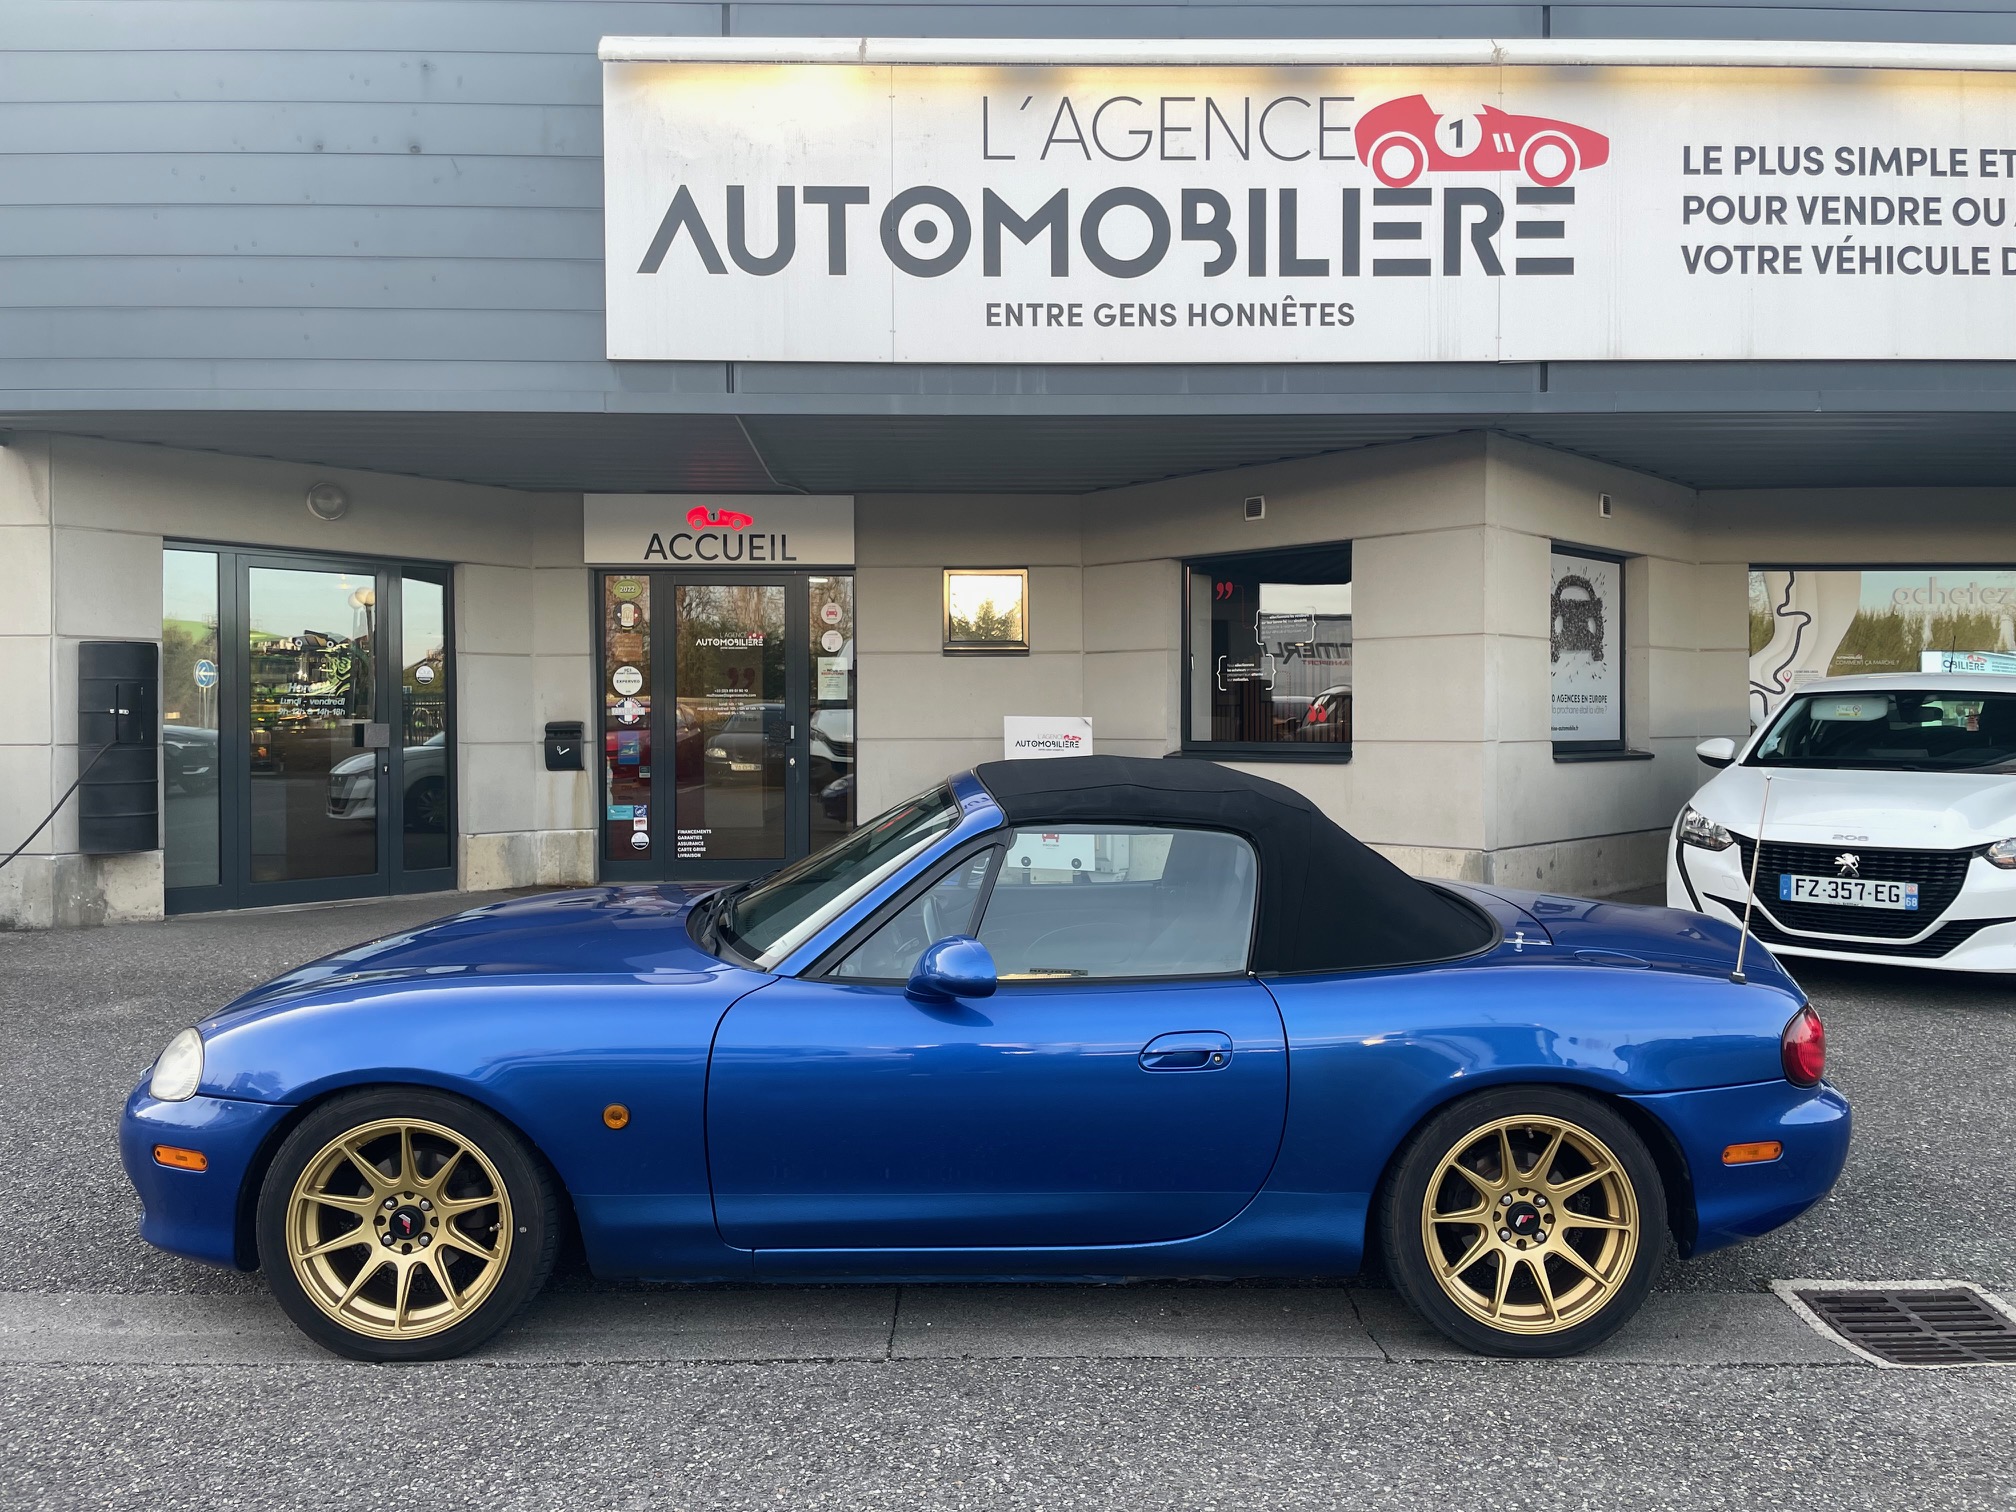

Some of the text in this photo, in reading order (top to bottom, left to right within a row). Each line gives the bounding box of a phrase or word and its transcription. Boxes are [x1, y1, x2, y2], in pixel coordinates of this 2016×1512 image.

[983, 95, 1356, 162] L'AGENCE
[1449, 118, 1463, 148] 1
[1683, 145, 2016, 178] LE PLUS SIMPLE ET
[1683, 195, 2006, 227] POUR VENDRE OU
[1681, 244, 1802, 275] VOTRE
[1811, 234, 1991, 276] VÉHICULE
[986, 294, 1355, 327] ENTRE GENS HONNÊTES
[710, 512, 717, 521] 1
[643, 533, 797, 561] ACCUEIL
[619, 585, 636, 593] 2022
[280, 697, 302, 706] Lundi
[309, 697, 346, 706] vendredi
[1556, 694, 1580, 703] AGENCES
[1581, 694, 1588, 703] EN
[1589, 695, 1608, 704] EUROPE
[1795, 878, 1900, 903] FZ-357-EG
[1905, 897, 1918, 907] 68
